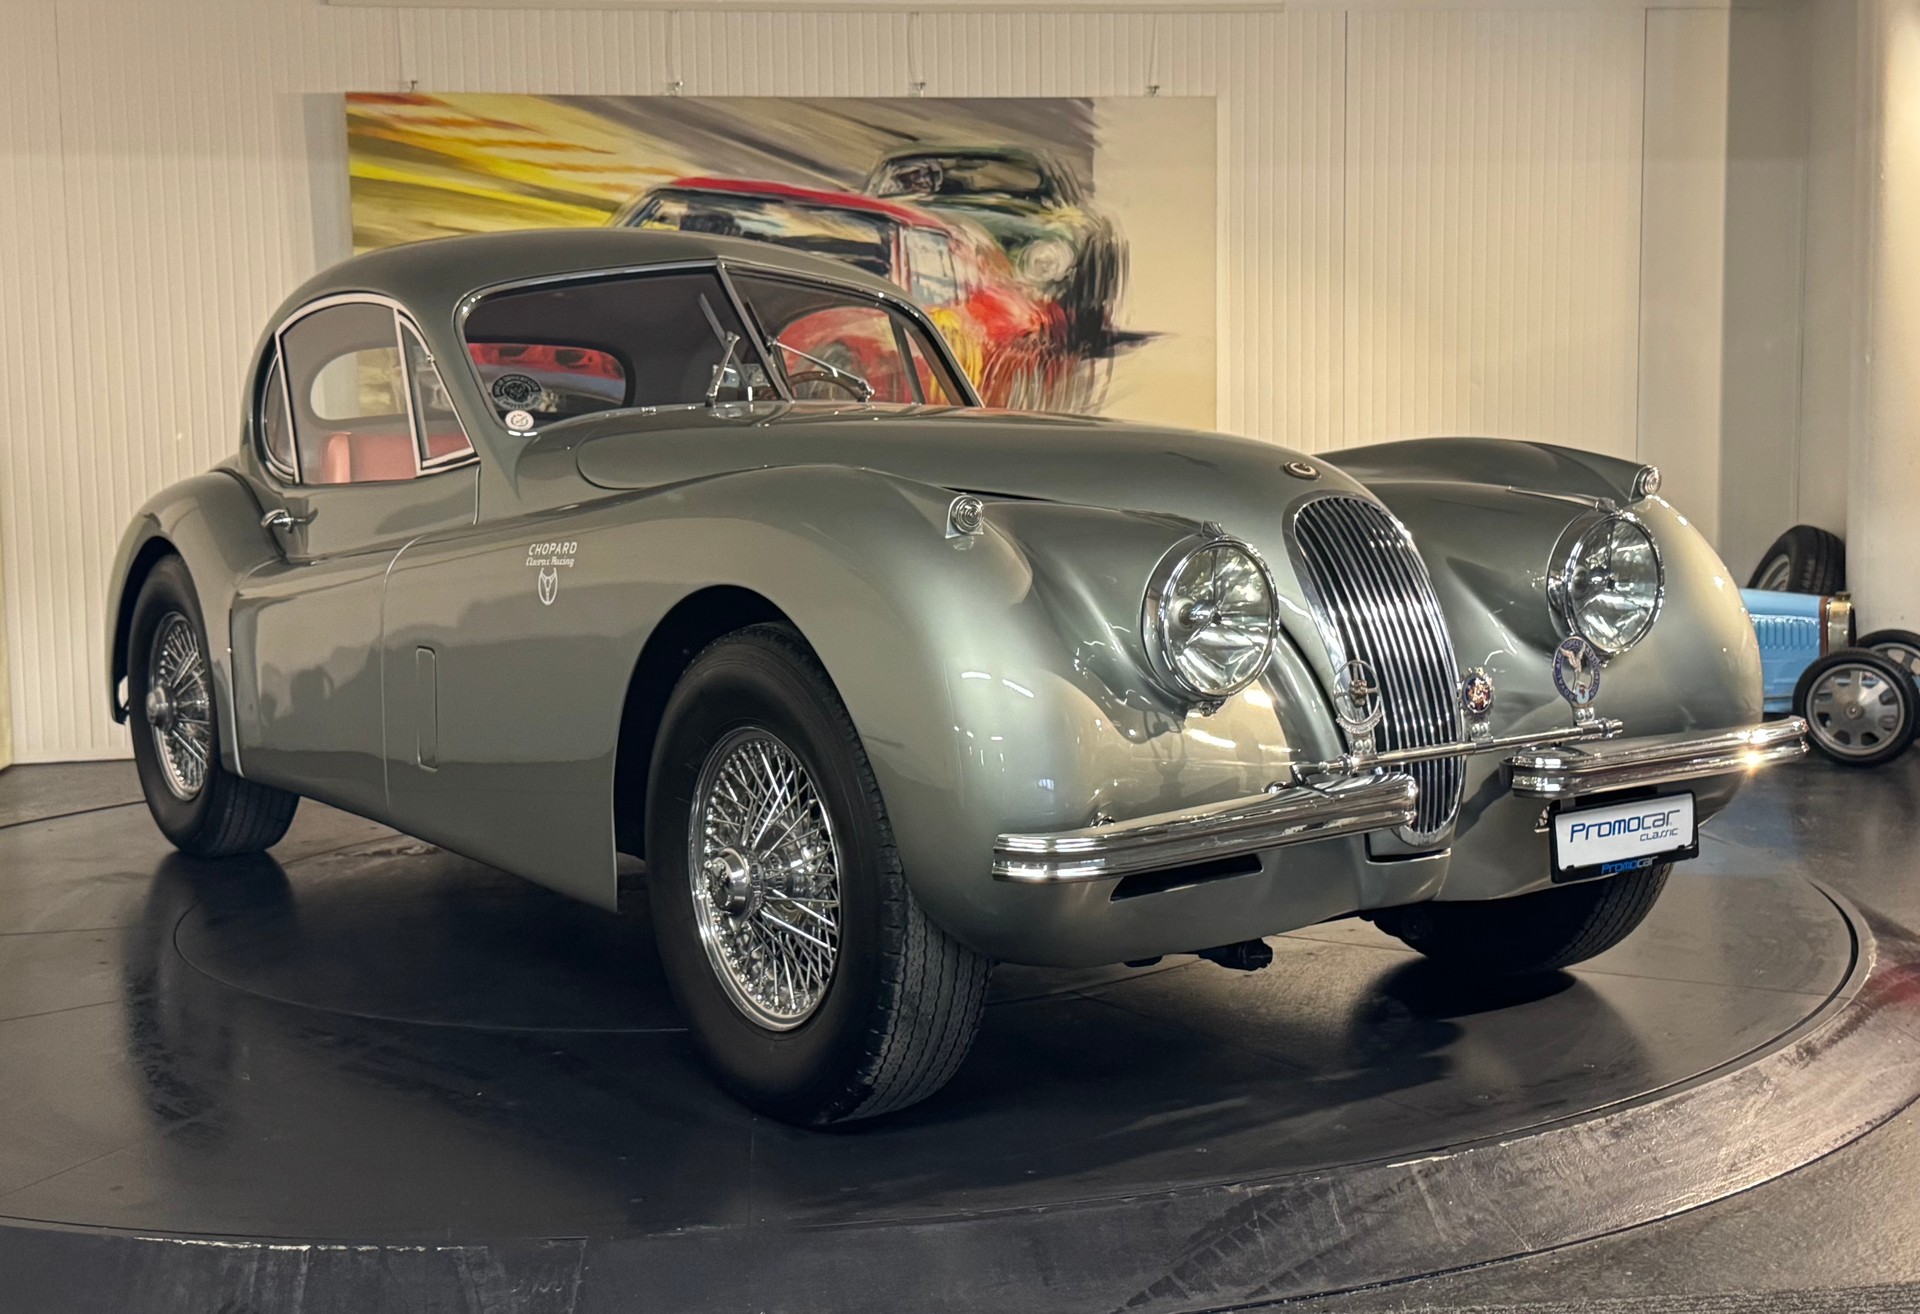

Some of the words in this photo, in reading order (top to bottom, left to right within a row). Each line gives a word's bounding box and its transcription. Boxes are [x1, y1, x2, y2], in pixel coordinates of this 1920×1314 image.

[528, 541, 578, 556] CHOPARD
[1569, 809, 1681, 843] Promocar
[1600, 855, 1659, 875] Promocar
